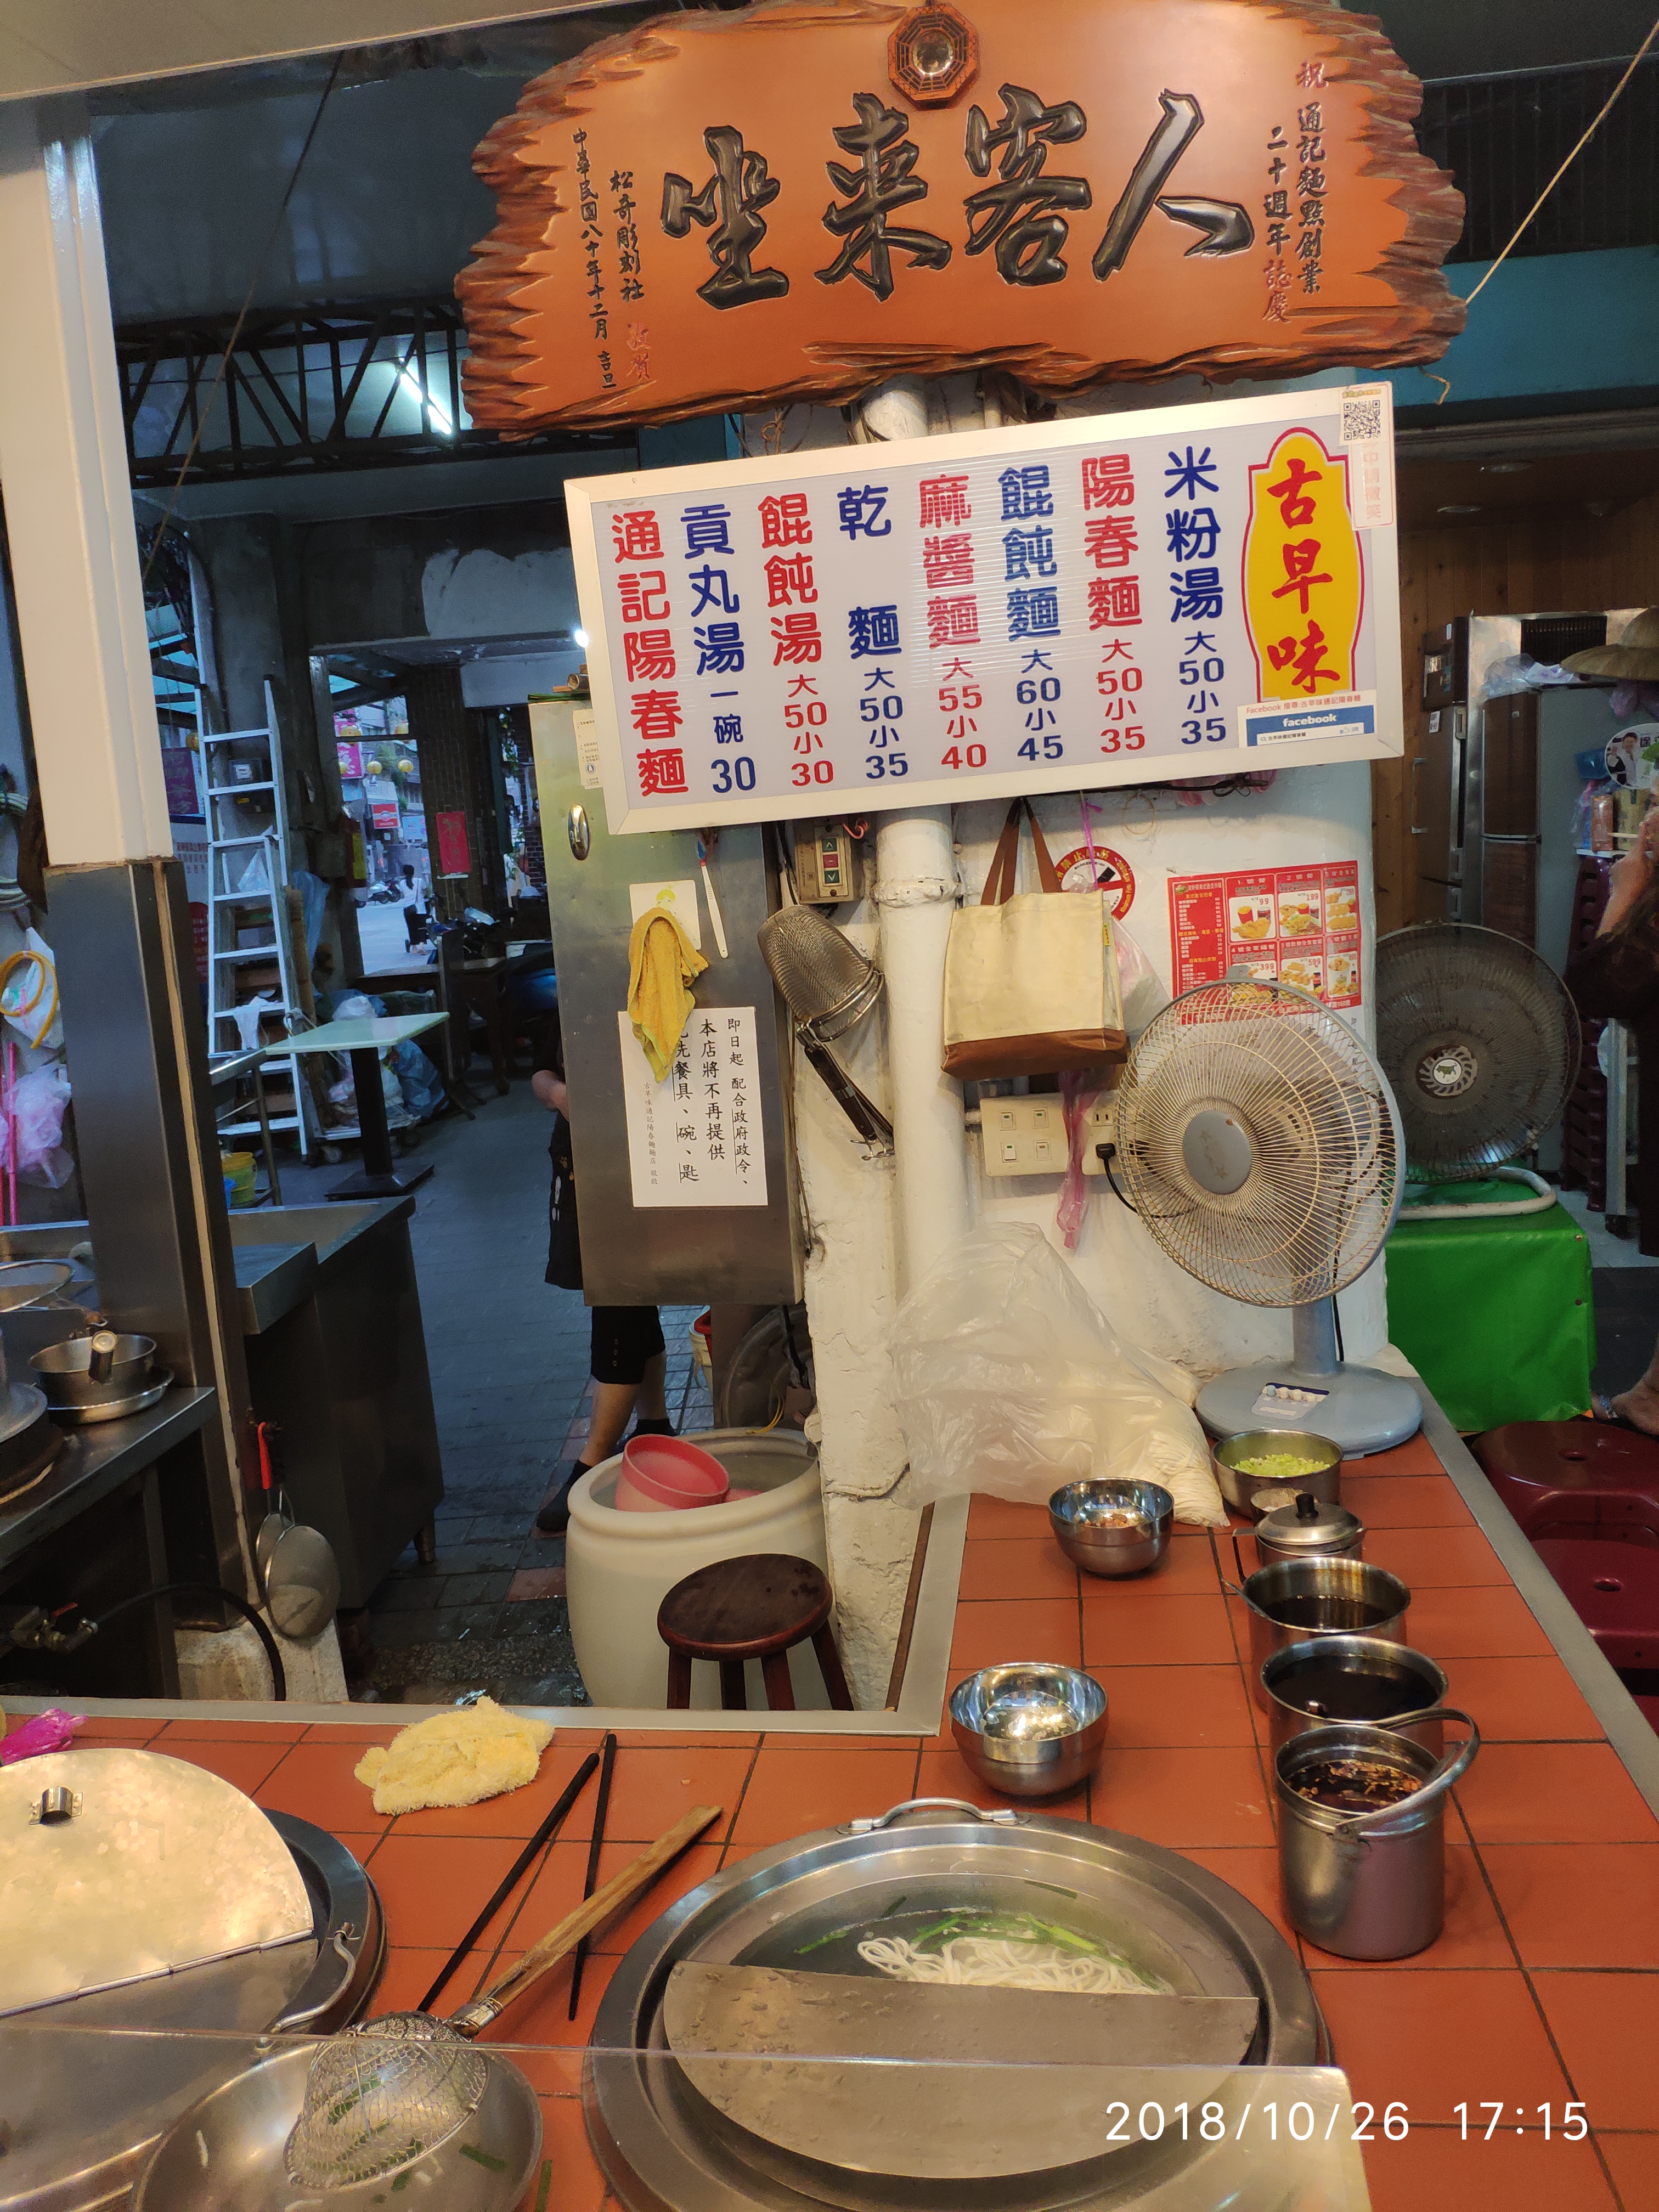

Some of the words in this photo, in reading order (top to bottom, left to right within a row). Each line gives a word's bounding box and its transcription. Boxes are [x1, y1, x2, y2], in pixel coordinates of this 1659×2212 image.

[1080, 453, 1143, 631] 陽春麵
[1164, 445, 1224, 622] 米粉湯
[918, 473, 982, 650] 麻醬麵
[997, 465, 1061, 642] 餛飩麵
[680, 503, 745, 675] 貢丸湯
[757, 492, 823, 667] 餛飩湯
[1267, 459, 1340, 693] 古早味
[610, 509, 690, 798] 通記陽春麵
[1096, 666, 1143, 696] 50
[1180, 657, 1224, 685] 50
[938, 683, 983, 713] 55
[1017, 677, 1061, 704] 60
[783, 701, 828, 729] 50
[860, 695, 903, 721] 50
[1246, 704, 1282, 714] Facebook
[1282, 713, 1338, 727] facebook
[1100, 725, 1146, 754] 35
[1182, 717, 1227, 744] 35
[940, 743, 988, 770] 40
[1018, 735, 1063, 760] 45
[711, 756, 756, 793] 30
[790, 759, 834, 787] 30
[866, 753, 908, 779] 35
[1306, 893, 1319, 901] 199
[727, 1018, 745, 1066] 即日起
[698, 1018, 726, 1161] 本店將不再提供
